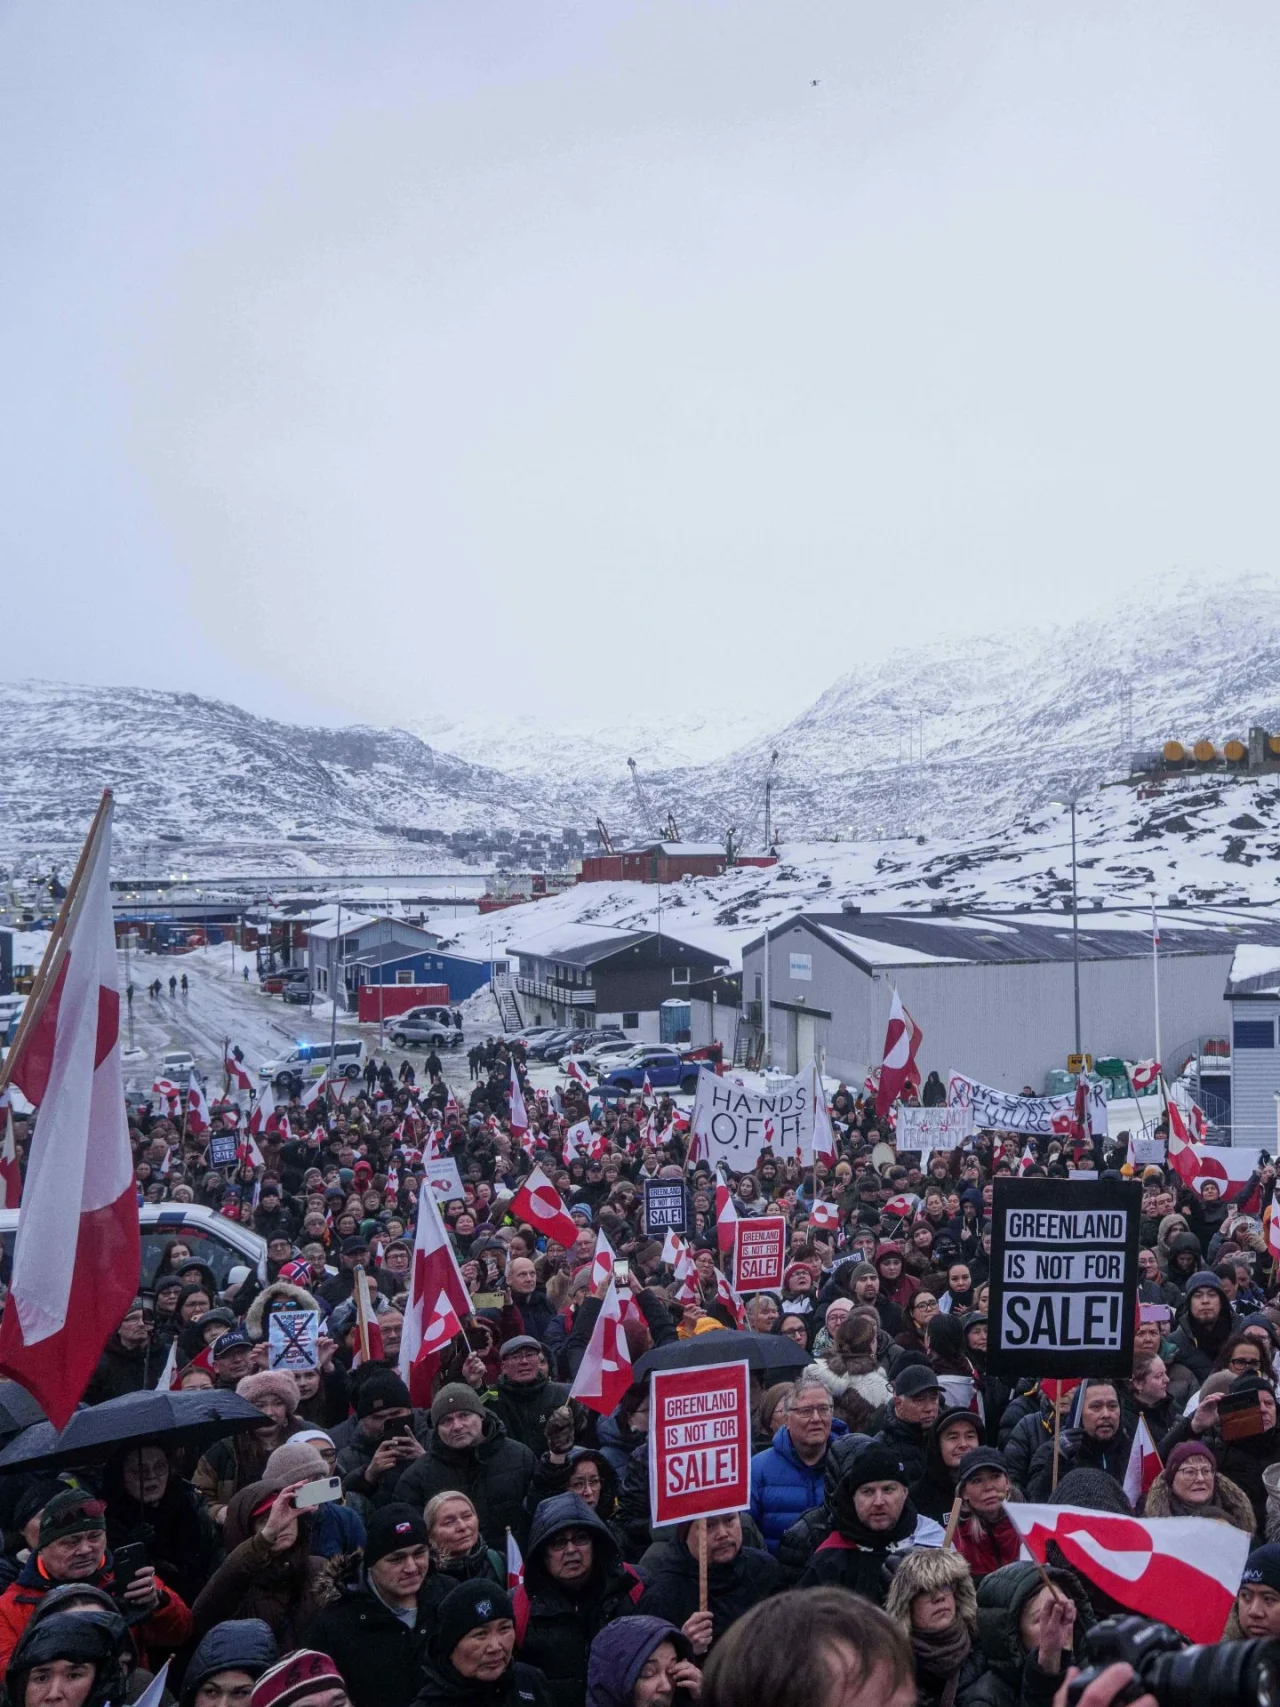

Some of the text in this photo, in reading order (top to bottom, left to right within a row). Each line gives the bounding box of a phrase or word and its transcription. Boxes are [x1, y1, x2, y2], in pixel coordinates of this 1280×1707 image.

[712, 1086, 806, 1113] HANDS
[972, 1084, 999, 1105] WE
[970, 1098, 1051, 1132] FUTURE
[650, 1188, 681, 1196] GREENLAND
[651, 1209, 681, 1224] SALE!
[1009, 1213, 1123, 1239] GREENLAND
[743, 1231, 778, 1241] GREENLAND
[752, 1246, 763, 1254] NOT
[766, 1245, 778, 1253] FOR
[742, 1259, 777, 1278] SALE!
[1007, 1254, 1120, 1279] IS NOT FOR
[1005, 1295, 1119, 1346] SALE!
[667, 1391, 736, 1417] GREENLAND
[667, 1419, 736, 1446] IS NOT FOR
[668, 1447, 737, 1493] SALE!
